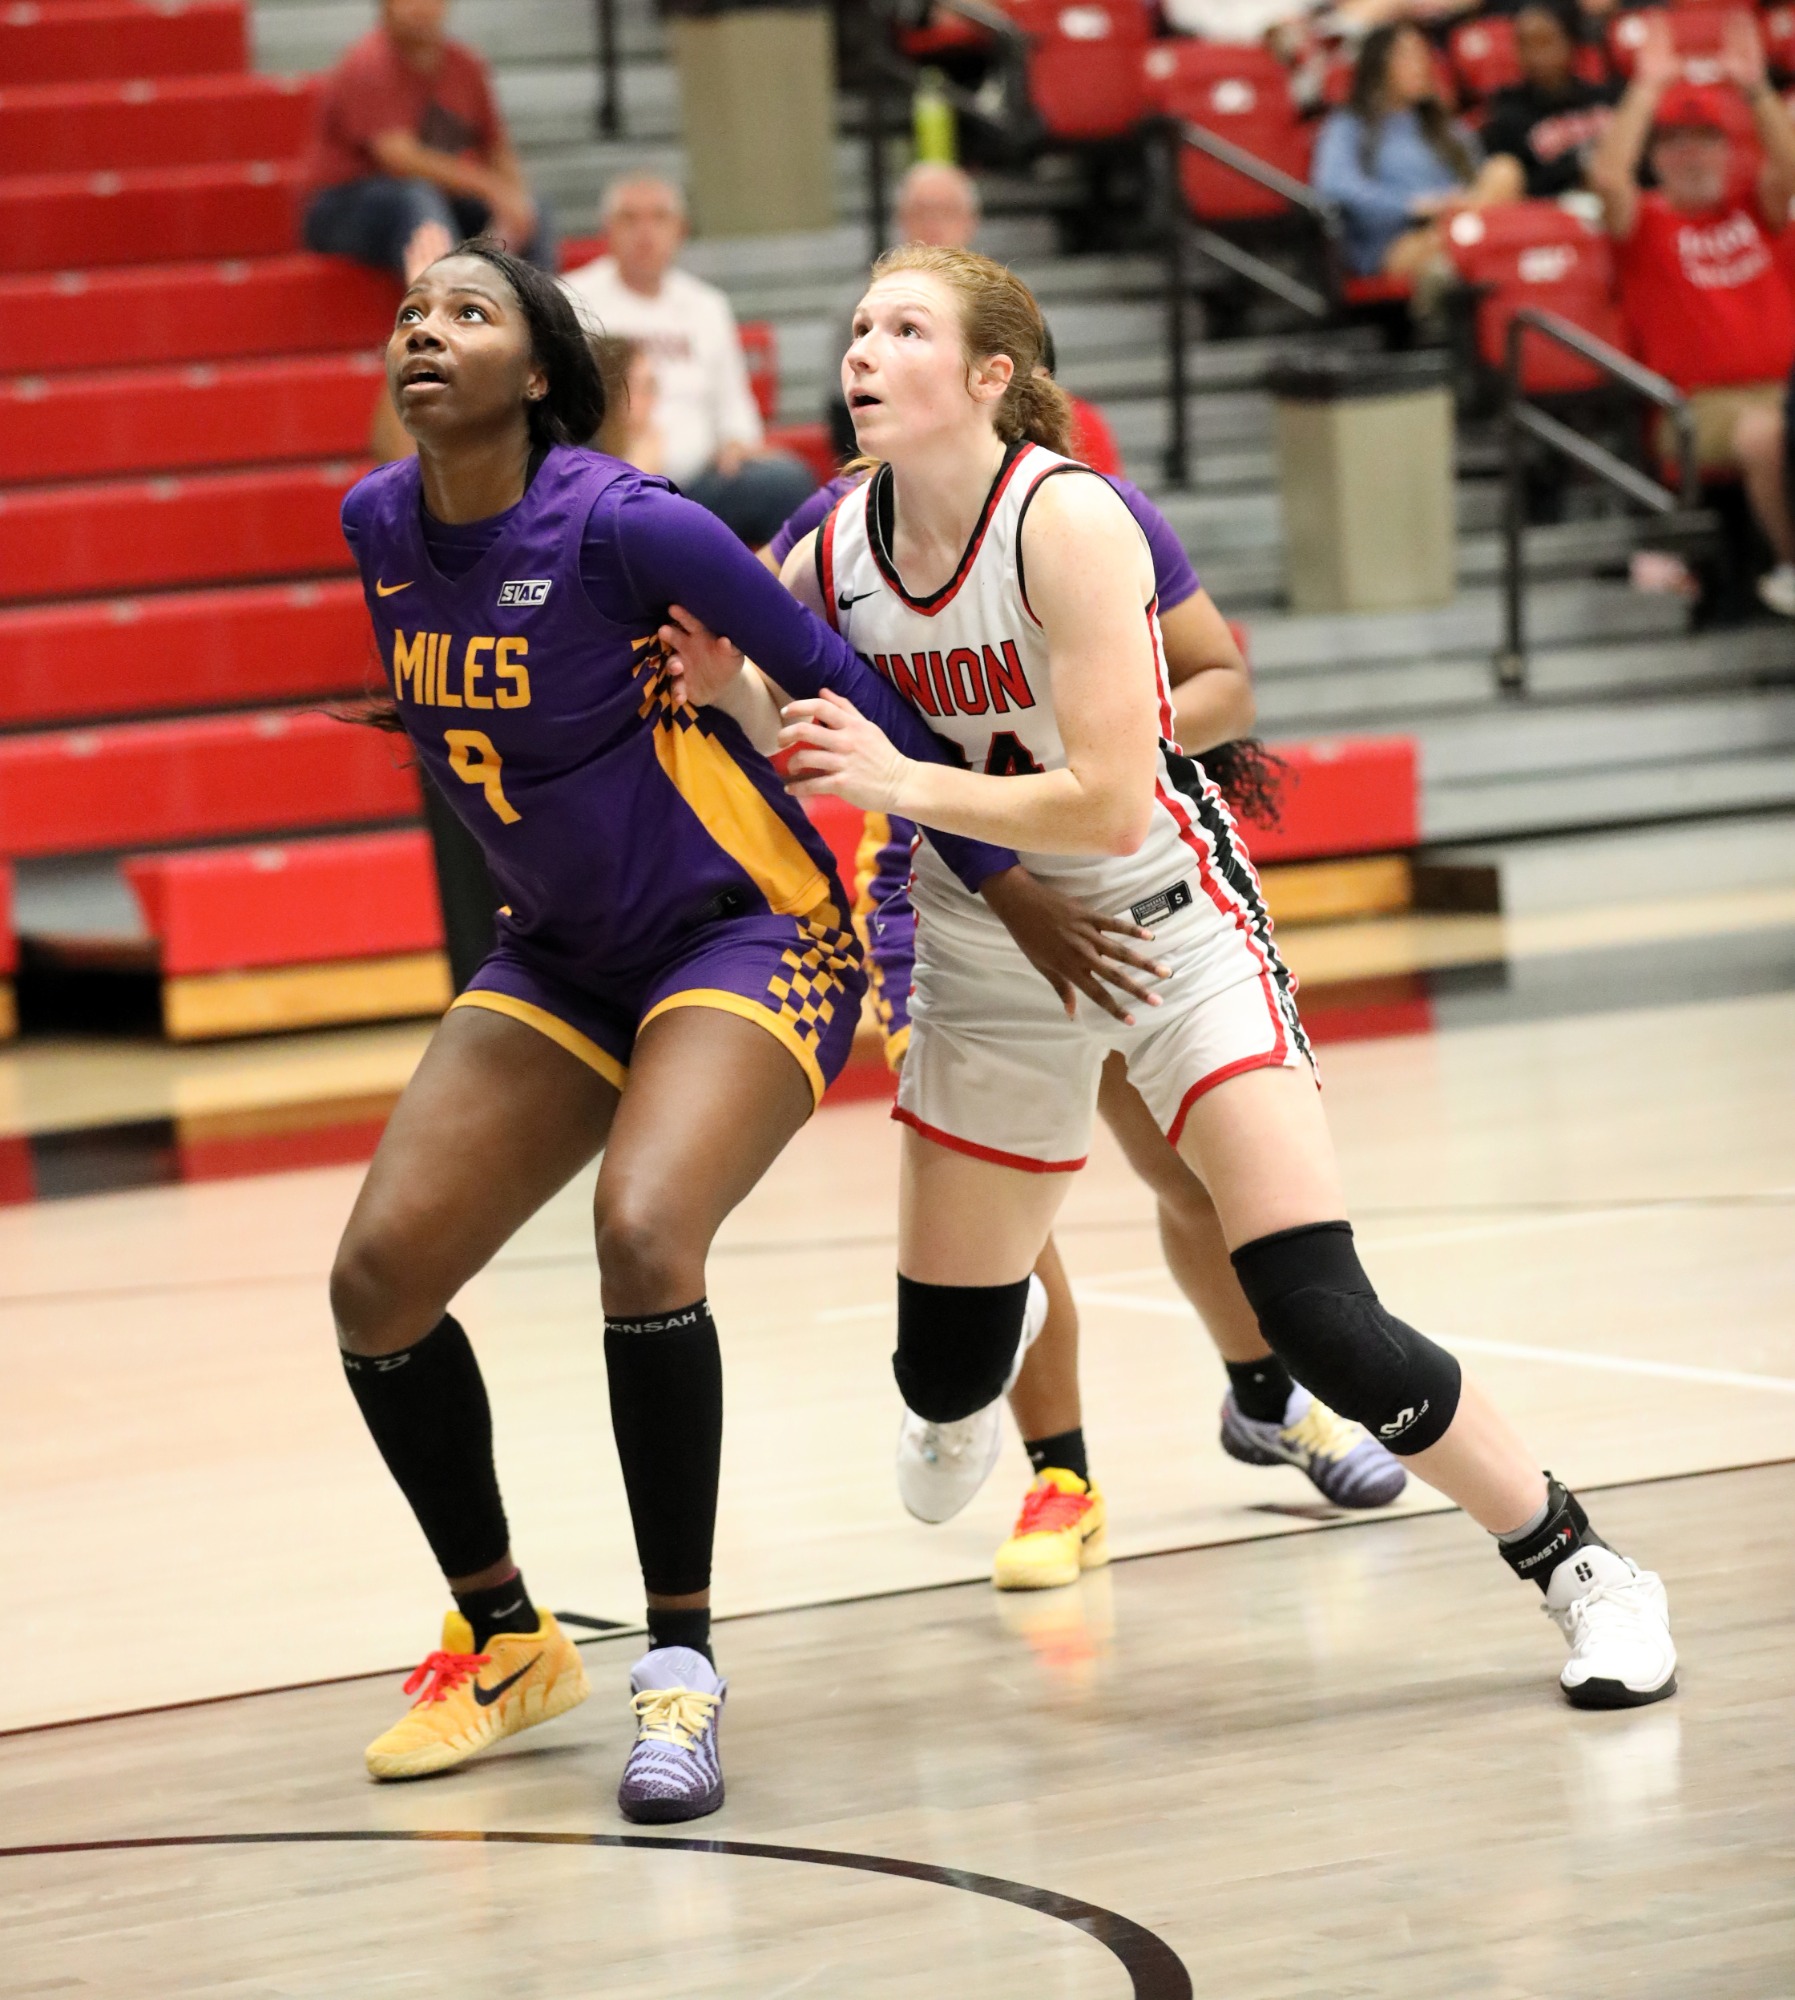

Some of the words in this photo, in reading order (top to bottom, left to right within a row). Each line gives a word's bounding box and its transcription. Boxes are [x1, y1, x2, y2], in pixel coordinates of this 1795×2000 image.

[501, 584, 546, 602] SIAC
[393, 629, 531, 710] MILES
[872, 639, 1036, 717] NION
[443, 729, 522, 825] 9
[1174, 892, 1184, 905] S
